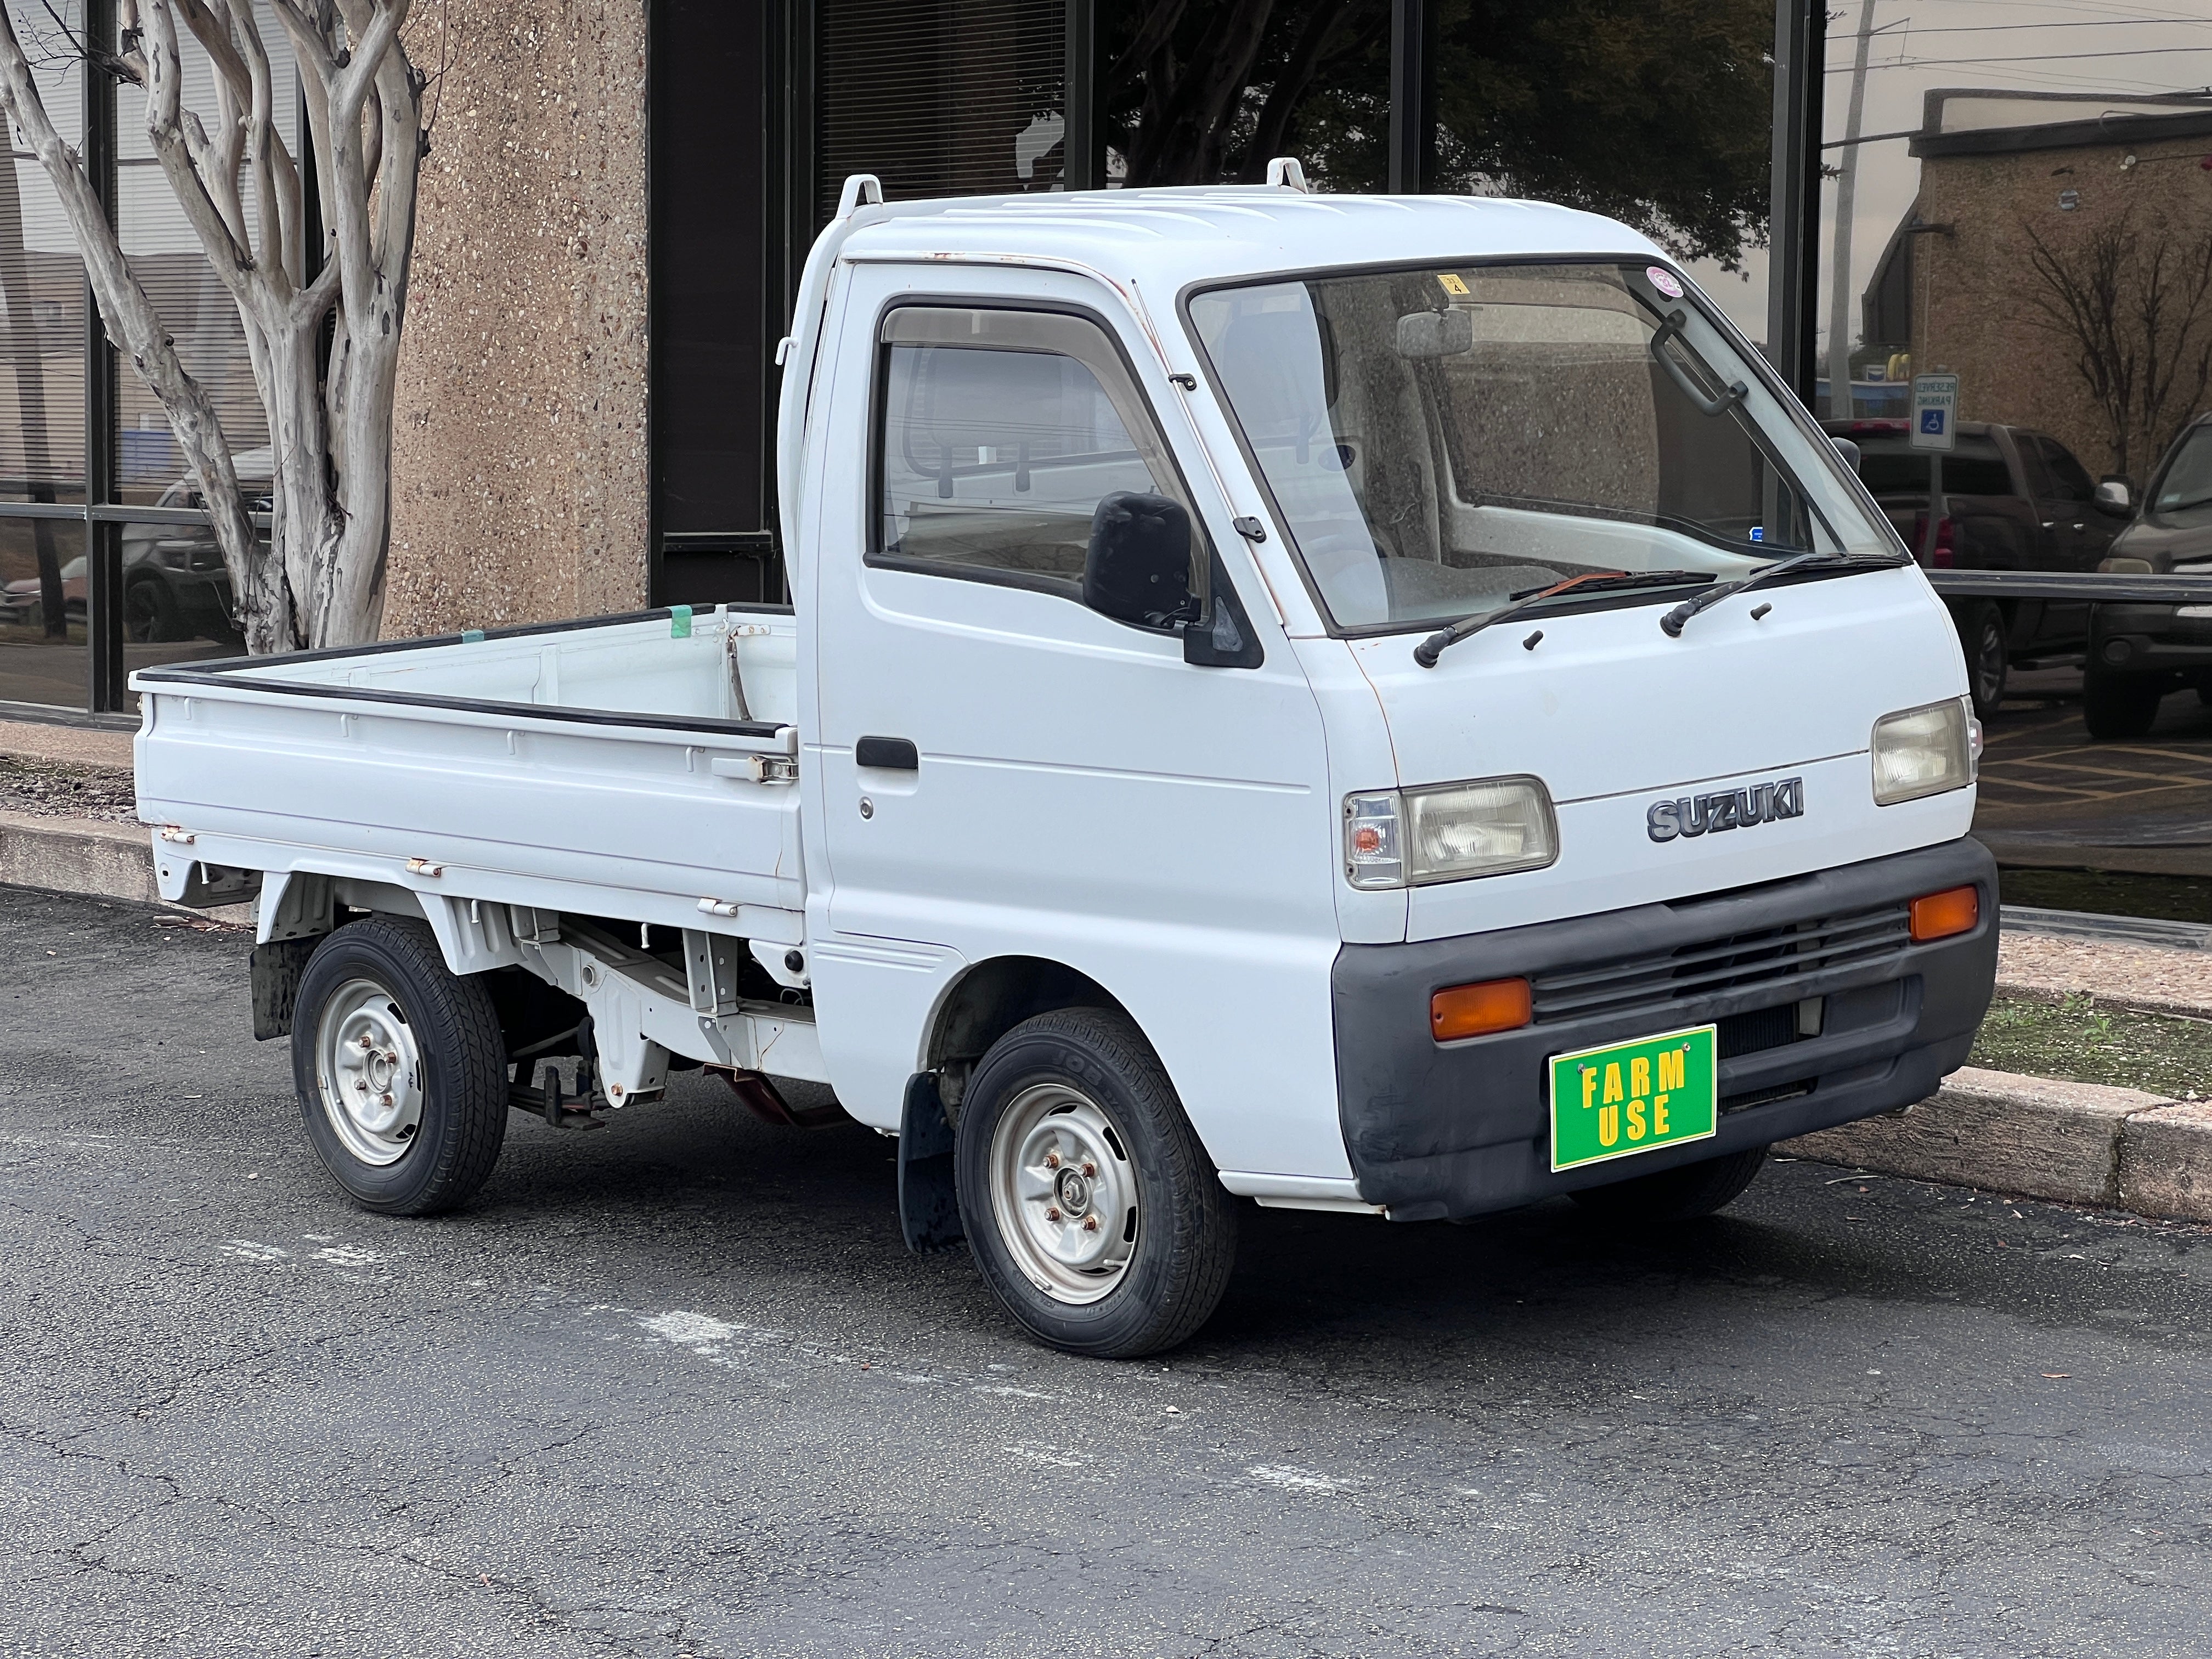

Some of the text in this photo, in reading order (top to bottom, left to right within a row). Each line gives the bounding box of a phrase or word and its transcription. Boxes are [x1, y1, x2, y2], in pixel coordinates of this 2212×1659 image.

[1454, 284, 1462, 293] 4
[1647, 776, 1804, 843] SUZUKI
[1582, 1049, 1685, 1109] FARM
[1599, 1094, 1669, 1147] USE
